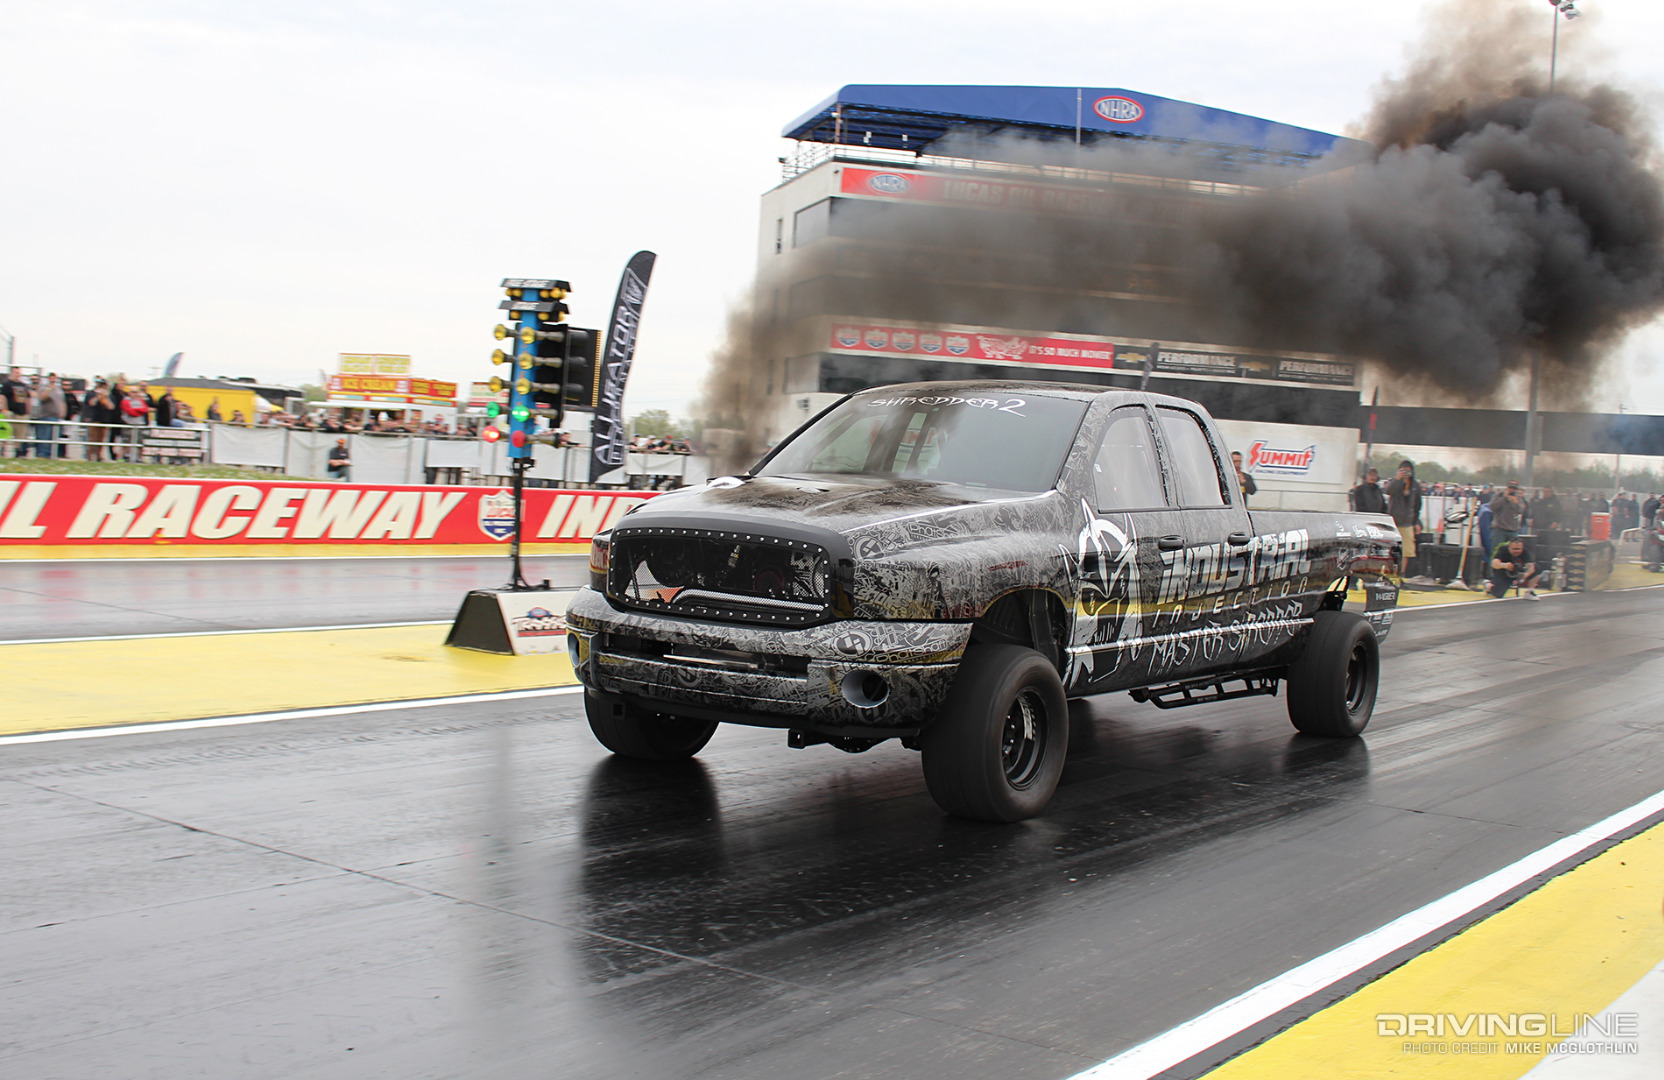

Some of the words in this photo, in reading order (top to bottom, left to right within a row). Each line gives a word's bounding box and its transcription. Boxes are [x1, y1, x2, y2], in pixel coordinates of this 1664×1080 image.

[1099, 100, 1140, 119] NHRA
[943, 180, 1004, 204] LUCAS
[1007, 187, 1036, 207] OIL
[1157, 352, 1236, 367] PERFORMANCE
[868, 396, 999, 409] SHREDDER
[999, 399, 1026, 417] 2
[0, 480, 58, 538] L
[65, 483, 468, 540] RACEWAY
